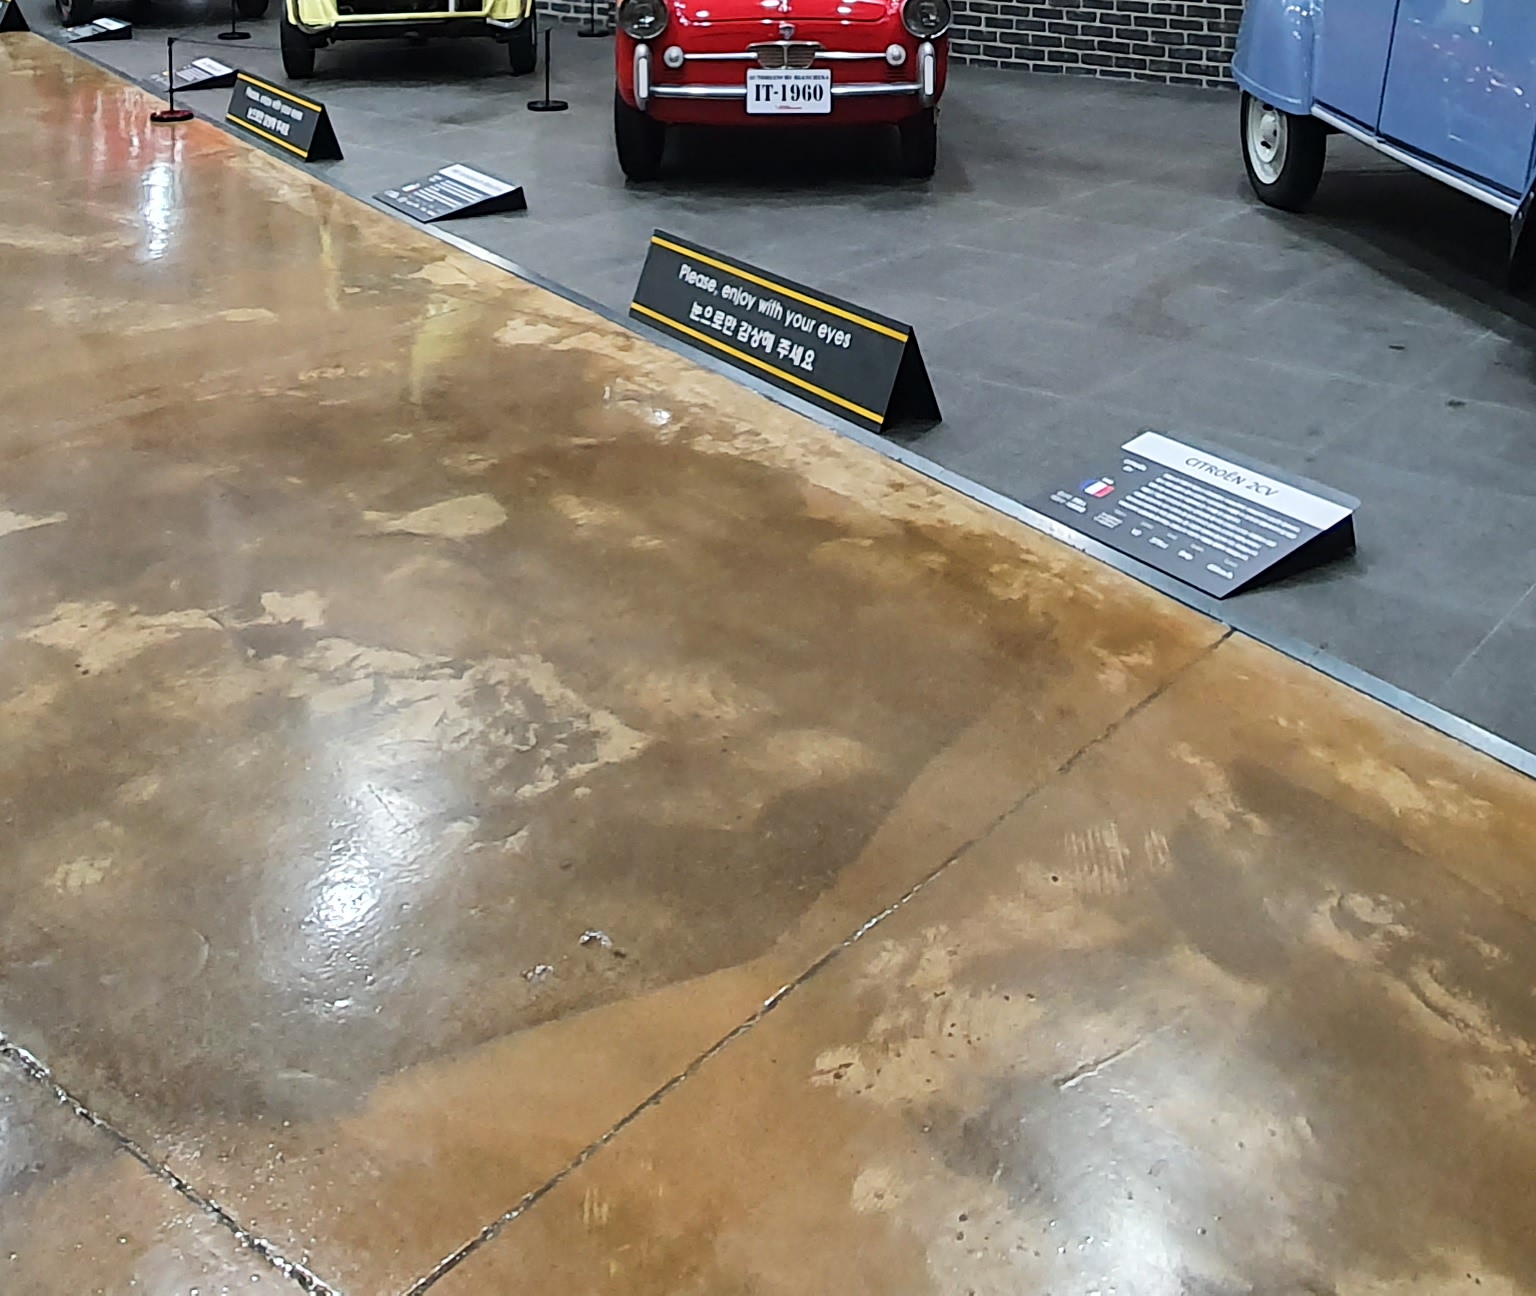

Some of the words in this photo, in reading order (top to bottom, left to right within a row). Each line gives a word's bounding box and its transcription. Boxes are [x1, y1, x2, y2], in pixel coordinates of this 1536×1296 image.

[755, 83, 824, 102] IT-1960
[678, 263, 718, 297] Please,
[721, 284, 757, 311] enjoy
[758, 298, 784, 321] with
[784, 309, 817, 334] your
[817, 323, 852, 349] eyes
[689, 301, 737, 336] 눈으로만
[736, 320, 776, 354] 감상해
[776, 337, 815, 372] 주세요
[1245, 481, 1279, 496] 2CV
